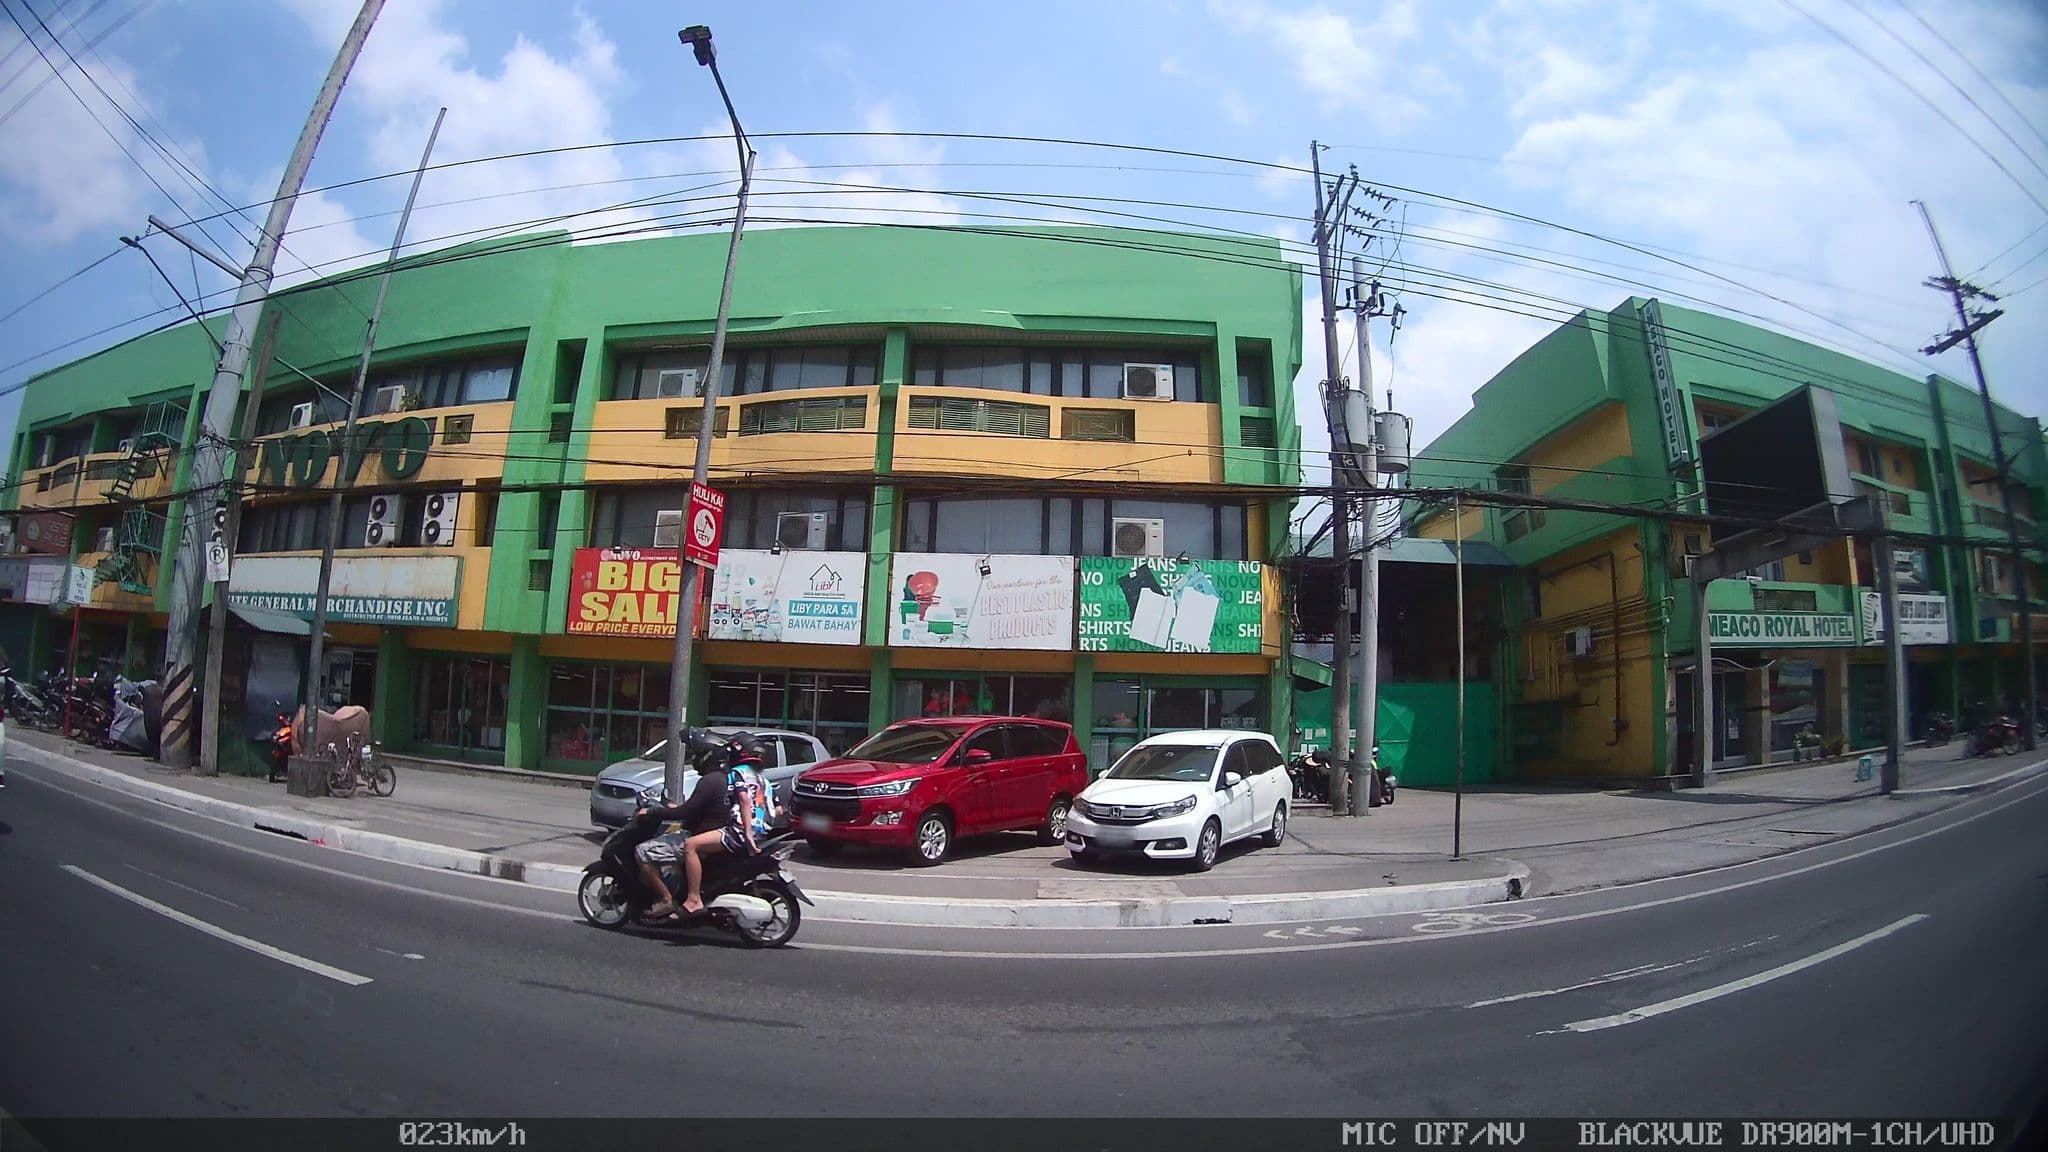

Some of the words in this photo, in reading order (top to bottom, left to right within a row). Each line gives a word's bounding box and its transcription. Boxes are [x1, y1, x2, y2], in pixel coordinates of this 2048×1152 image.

[1661, 386, 1679, 459] HOTEL
[693, 484, 710, 502] HULI
[710, 492, 724, 508] KA!
[597, 561, 680, 592] BIG
[250, 595, 305, 612] GENERAL
[306, 597, 413, 616] MRCHANDISE
[416, 600, 449, 617] INC.
[791, 602, 812, 614] LIBY
[814, 603, 838, 615] PARA
[841, 604, 853, 616] SA
[569, 620, 594, 633] LOW
[595, 623, 630, 635] PRICE
[787, 618, 822, 630] BAWAT
[824, 619, 857, 631] BAHAY
[989, 613, 1056, 641] PRODUCTS
[1079, 620, 1131, 635] SHIRTS
[1764, 615, 1811, 638] ROYAL
[1813, 616, 1852, 638] HOTEL
